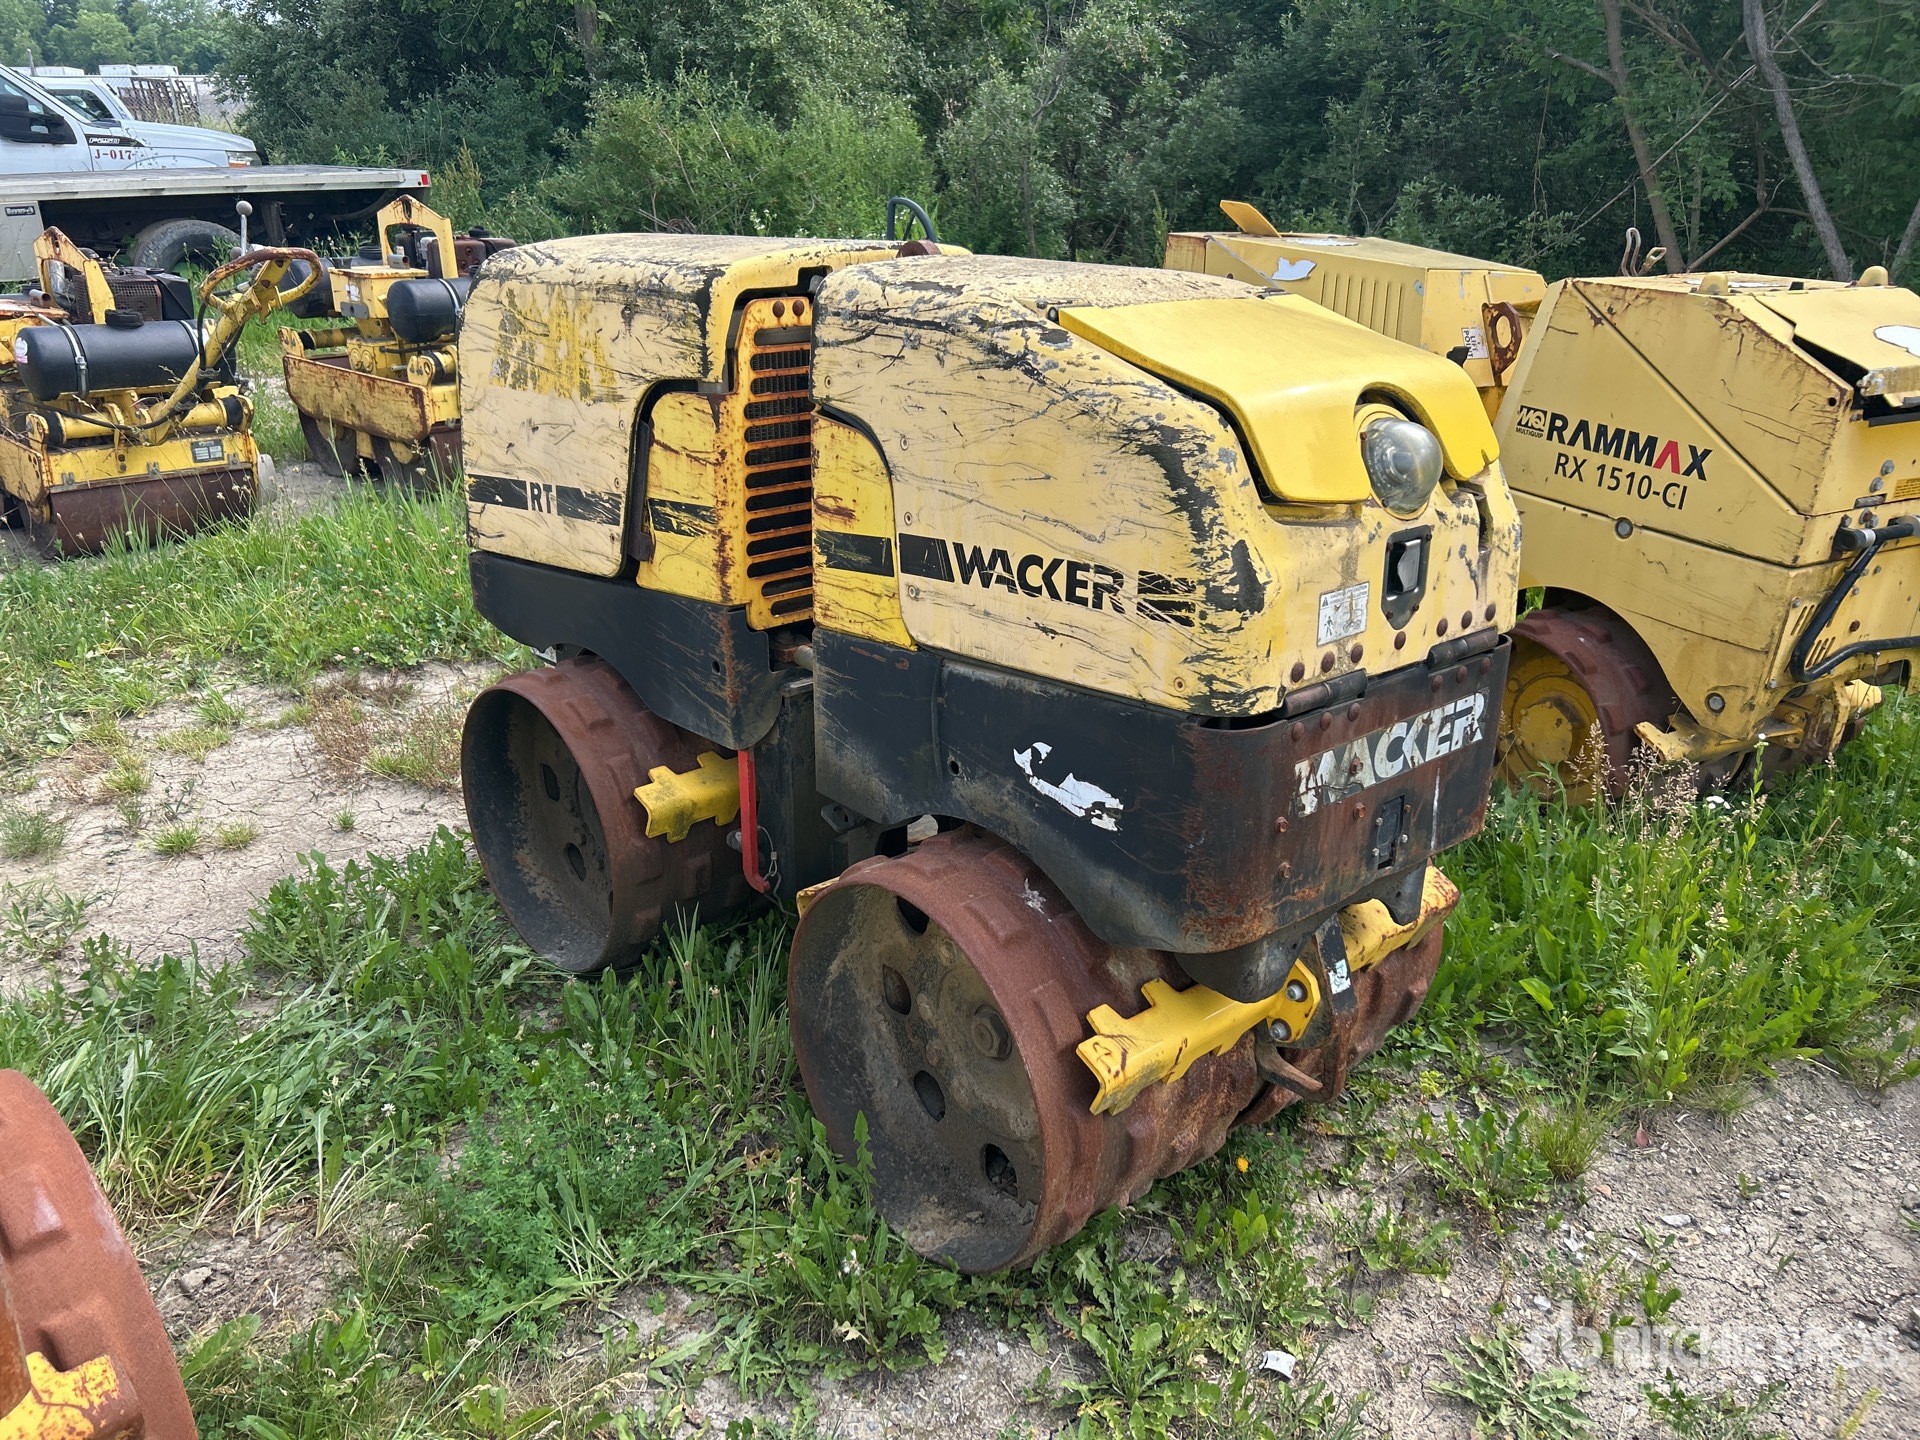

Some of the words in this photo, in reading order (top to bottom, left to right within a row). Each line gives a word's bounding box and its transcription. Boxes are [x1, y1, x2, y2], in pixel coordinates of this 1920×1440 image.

[95, 149, 132, 160] J-017
[1515, 427, 1544, 439] MULTIQUIP
[1518, 406, 1546, 431] MQ
[1546, 412, 1713, 482] RAMMAX
[530, 482, 553, 514] RT
[1554, 453, 1588, 483] RX
[1596, 463, 1688, 510] 1510-CI
[952, 541, 1126, 615] WACKER
[1294, 692, 1485, 817] WACKER
